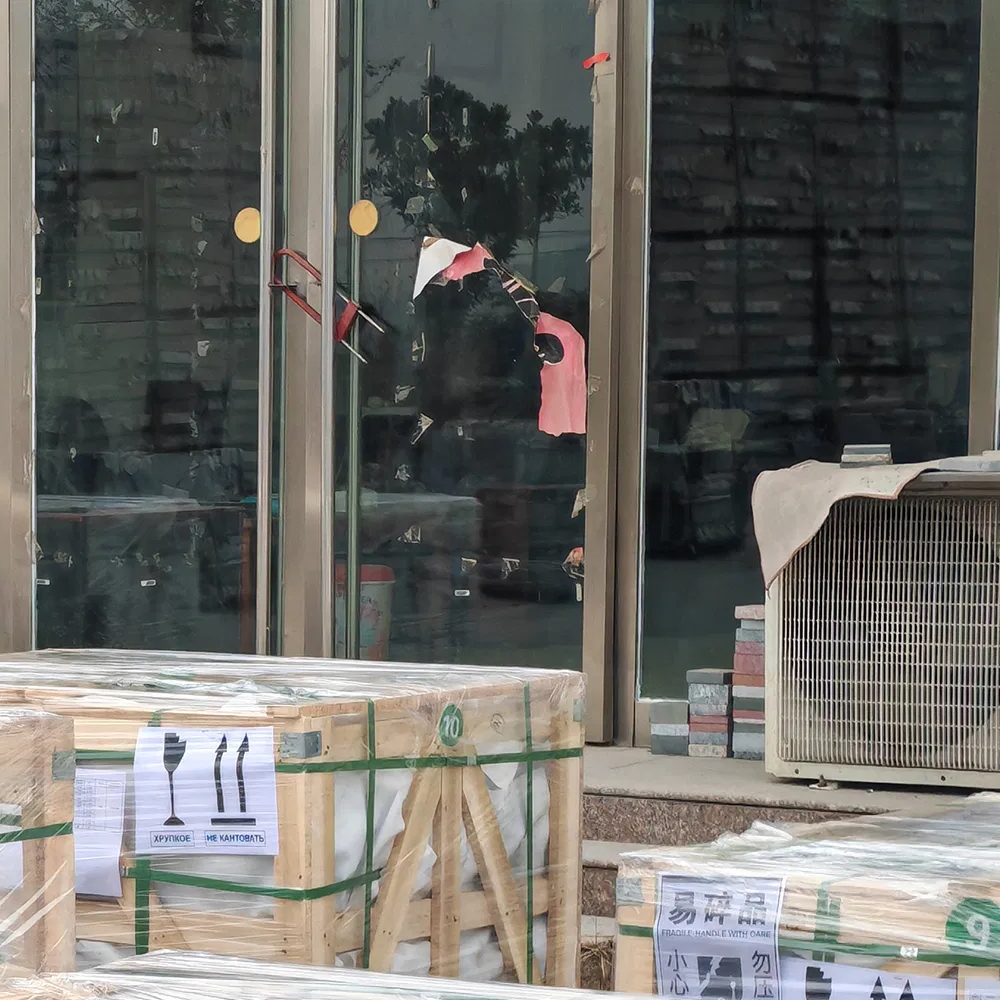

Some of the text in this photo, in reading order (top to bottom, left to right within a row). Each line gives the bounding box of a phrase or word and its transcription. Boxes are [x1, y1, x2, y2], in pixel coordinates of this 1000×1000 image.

[153, 834, 191, 843] ХРУПКОЕ
[206, 834, 265, 843] НЕ КАНТОВАТЬ
[668, 891, 767, 925] 易碎品
[728, 930, 748, 938] WITH
[966, 914, 991, 949] 9
[667, 949, 690, 996] 小心
